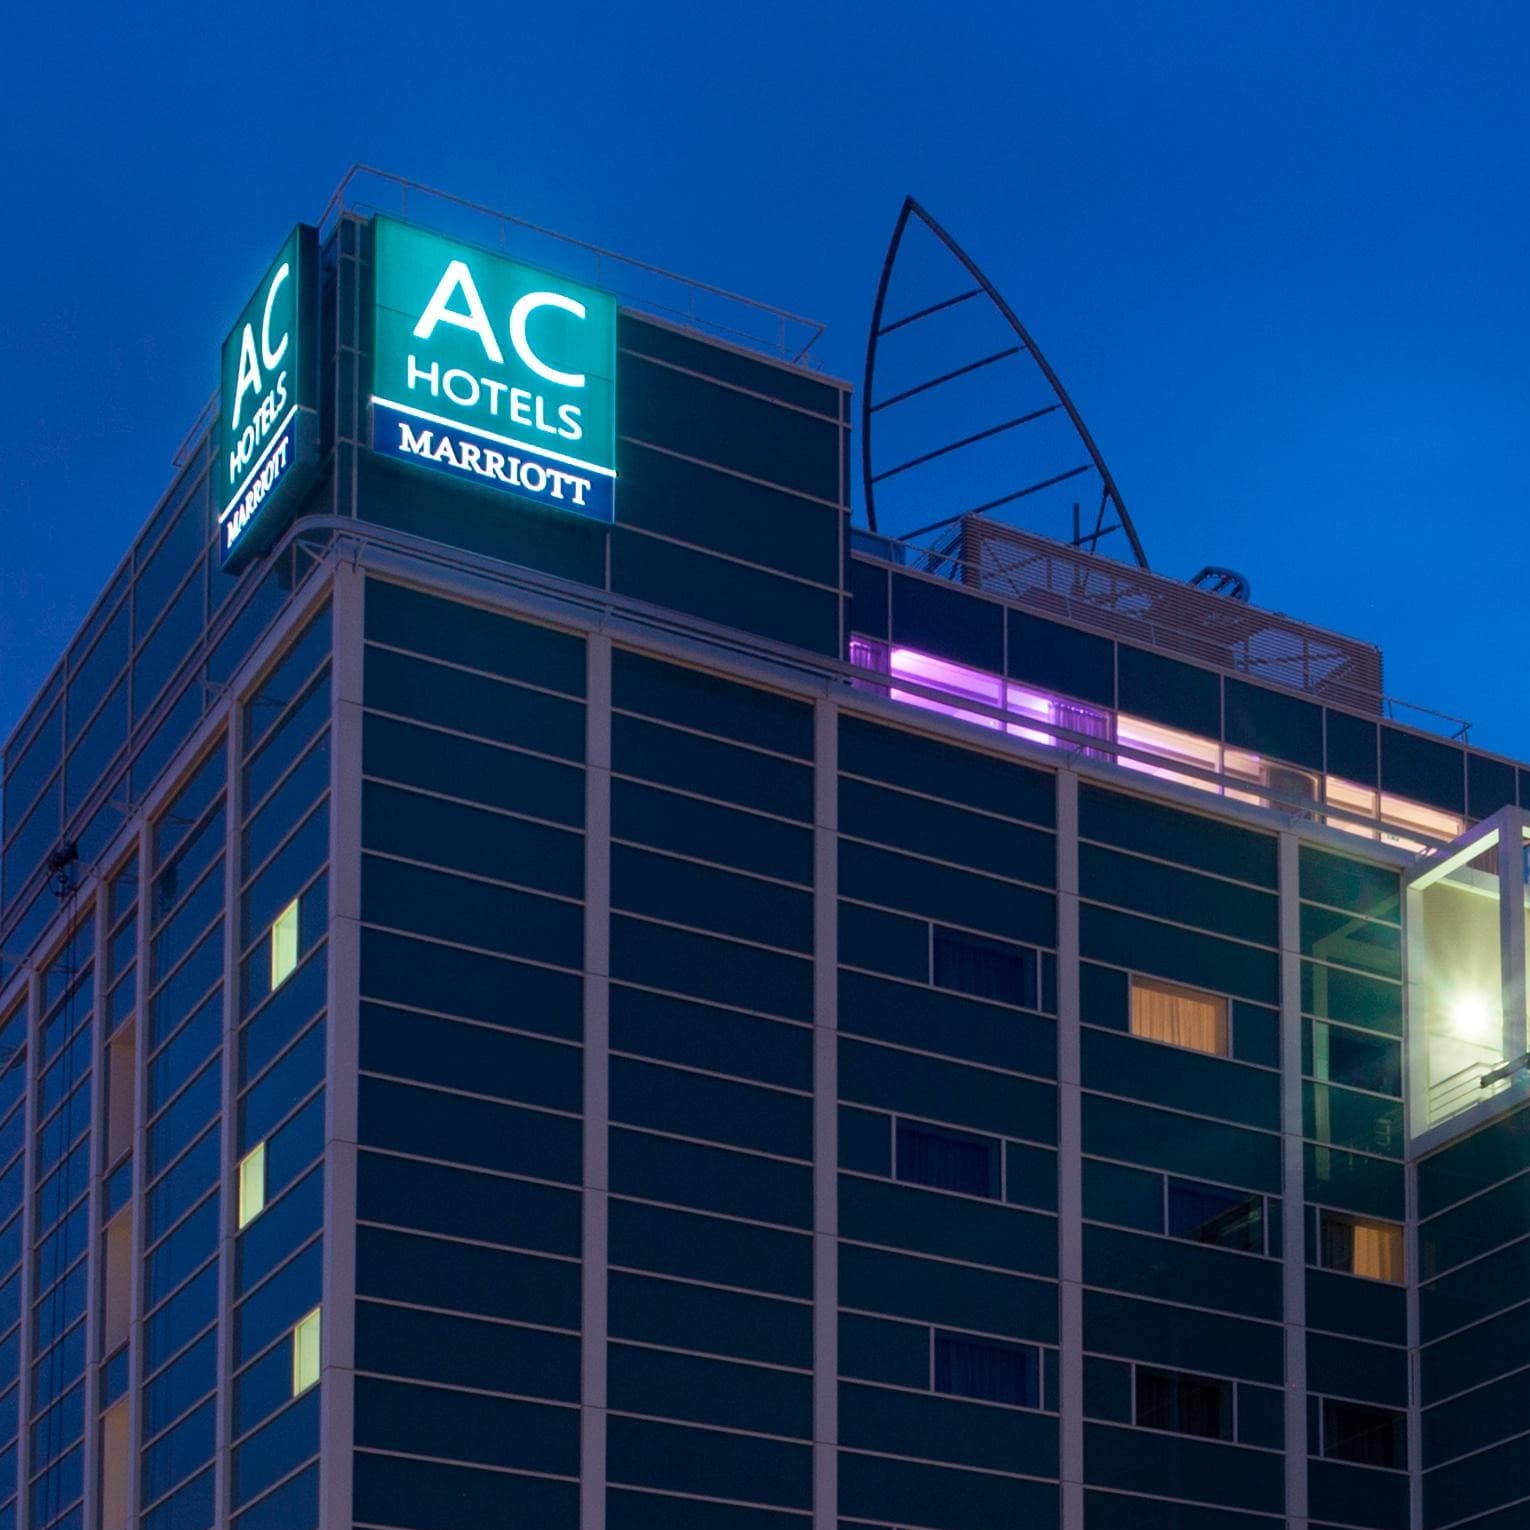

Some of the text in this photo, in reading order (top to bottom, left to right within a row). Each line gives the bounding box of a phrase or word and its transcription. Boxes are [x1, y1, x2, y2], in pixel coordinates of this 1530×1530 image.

[232, 262, 289, 429] AC
[413, 260, 586, 387] AC
[229, 371, 287, 482] HOTELS
[407, 354, 582, 440] HOTELS
[226, 436, 289, 548] MARRIOTT
[398, 422, 591, 506] MARRIOTT
